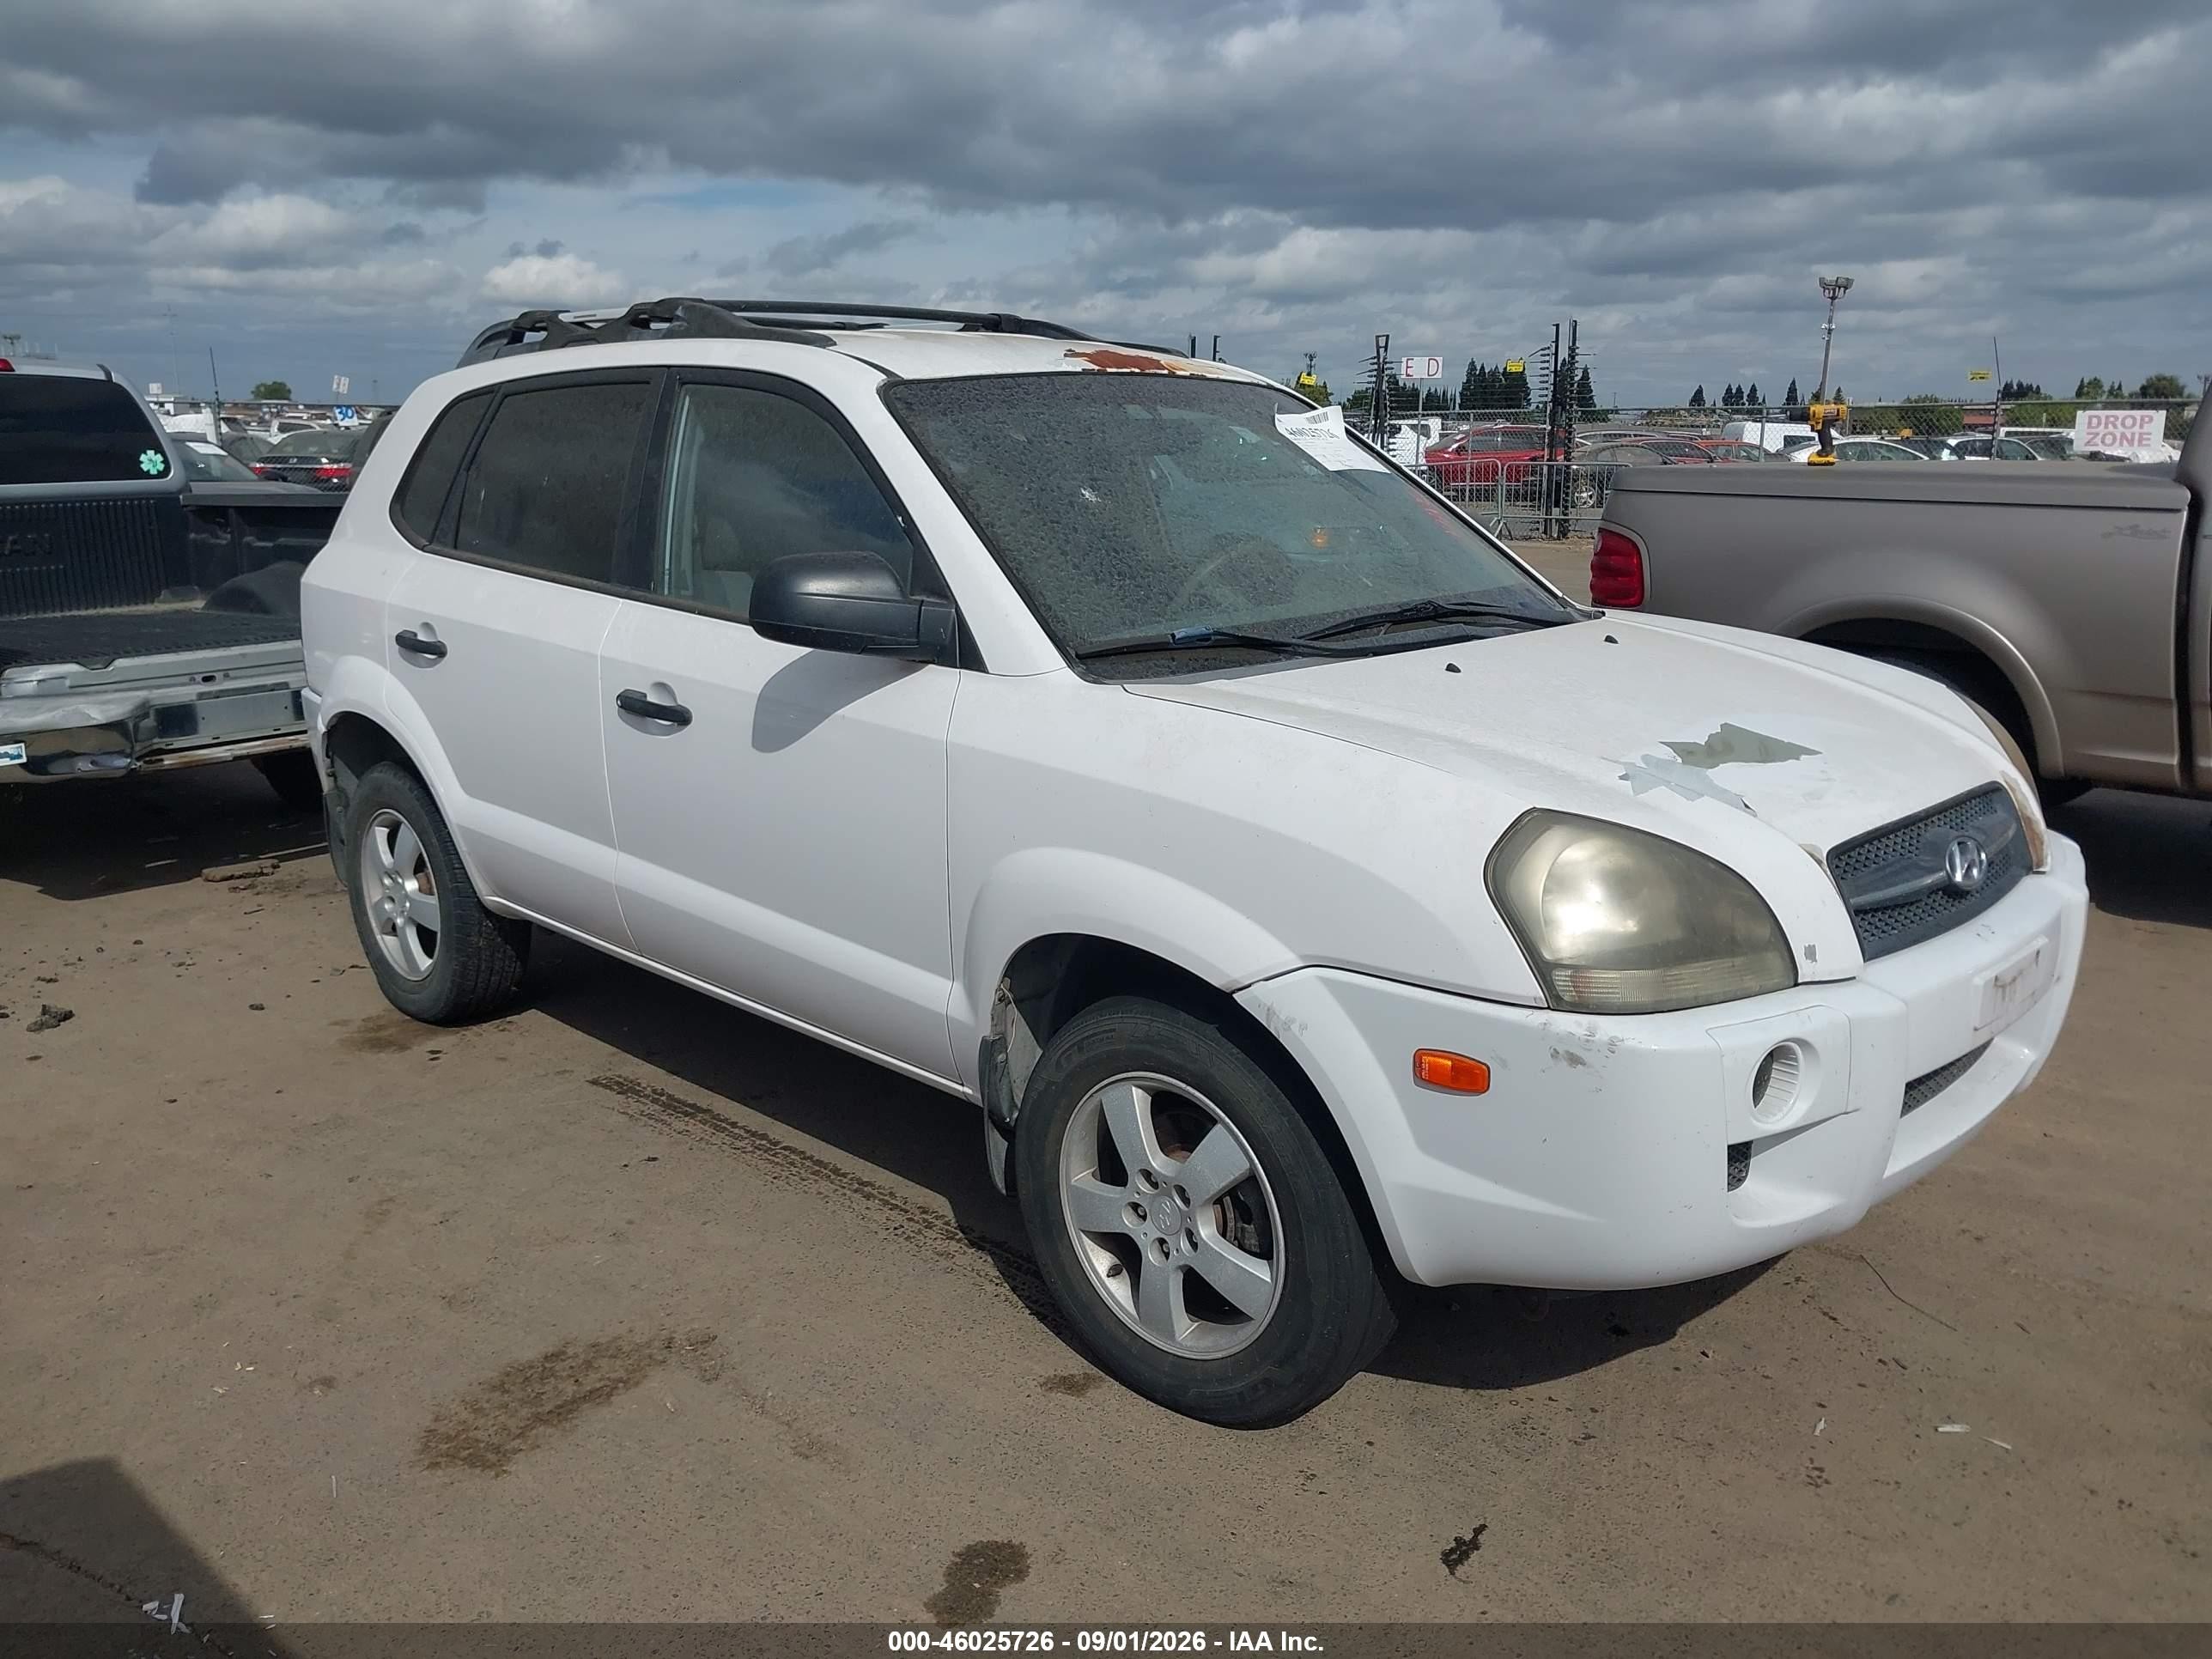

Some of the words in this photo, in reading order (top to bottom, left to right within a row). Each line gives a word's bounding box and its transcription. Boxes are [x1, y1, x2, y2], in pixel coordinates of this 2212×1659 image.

[1406, 358, 1414, 377] E
[1428, 358, 1439, 376] D
[336, 405, 356, 421] 30
[2086, 416, 2154, 430] DROP
[2083, 432, 2152, 447] ZONE
